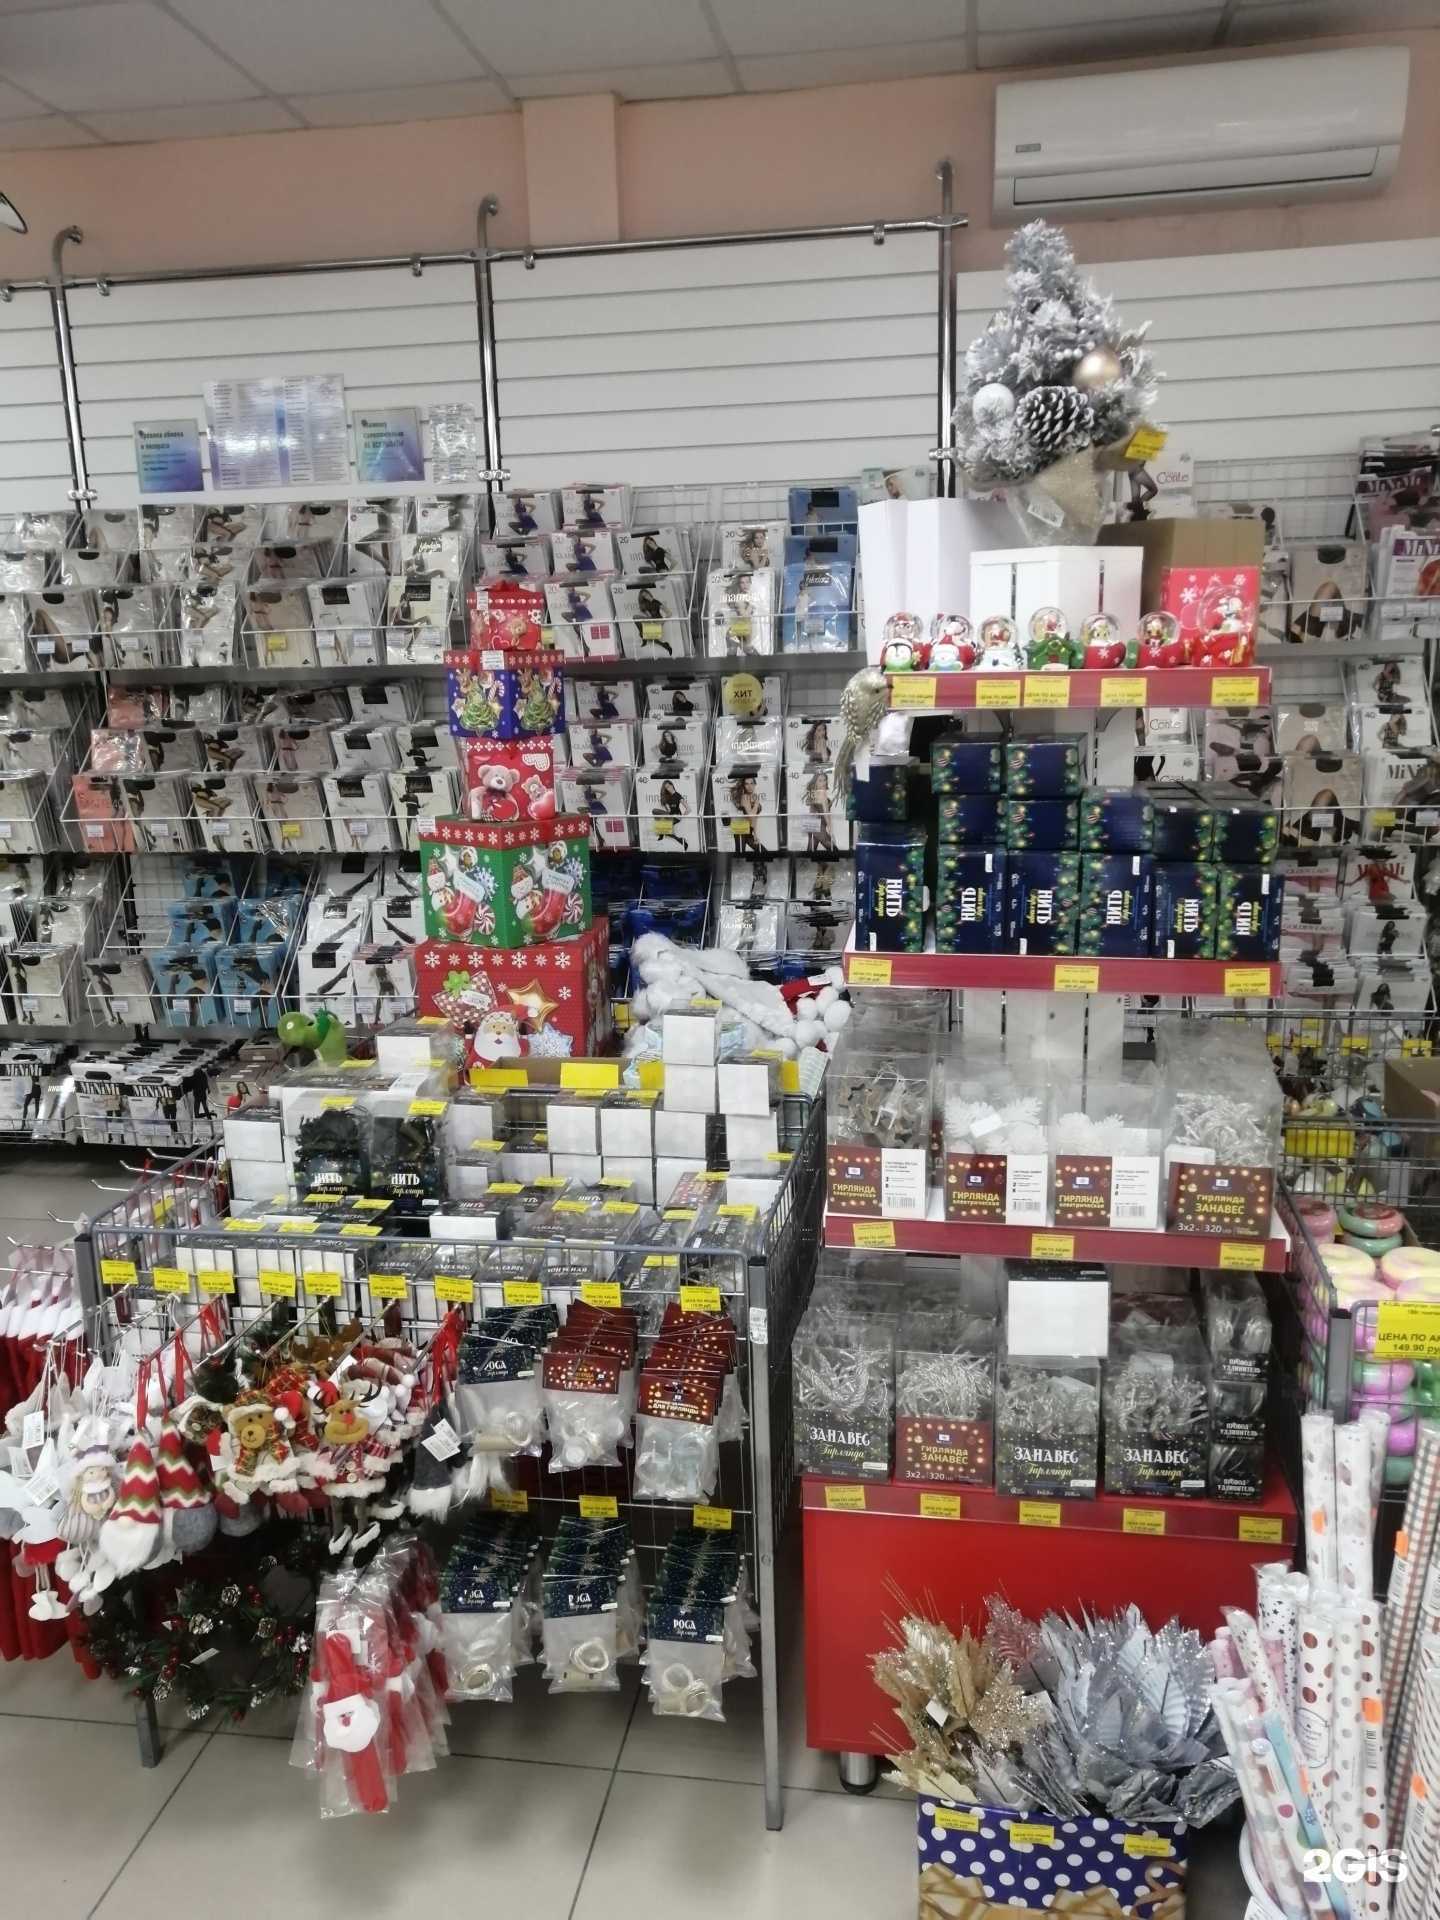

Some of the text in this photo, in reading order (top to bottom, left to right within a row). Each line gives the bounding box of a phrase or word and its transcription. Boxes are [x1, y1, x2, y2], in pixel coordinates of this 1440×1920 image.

[733, 690, 753, 698] ХИТ
[886, 878, 903, 918] НИТЬ
[960, 887, 977, 922] НИТЬ
[1036, 889, 1053, 925] НИТЬ
[1106, 889, 1122, 925] НИТЬ
[1183, 898, 1199, 933] НИТЬ
[1235, 901, 1253, 936] НИТЬ
[5, 1064, 43, 1077] MiNiMi
[80, 1080, 121, 1096] MiNiMi
[132, 1084, 174, 1099] MiNiMi
[832, 1183, 876, 1194] ГИРЛЯНДА
[952, 1191, 1000, 1202] ГИРЛЯНДА
[1058, 1195, 1105, 1205] ГИРЛЯНДА
[1195, 1203, 1245, 1215] ЗАНАВЕС
[1204, 1224, 1222, 1233] 320
[1379, 1332, 1408, 1342] ЦЕНА
[1411, 1333, 1427, 1342] ПО
[809, 1426, 871, 1447] ЗАНАВЕС
[920, 1453, 969, 1465] ЗАНАВЕС
[1014, 1446, 1079, 1464] ЗАНАВЕС
[1123, 1448, 1189, 1465] ЗАНАВЕС
